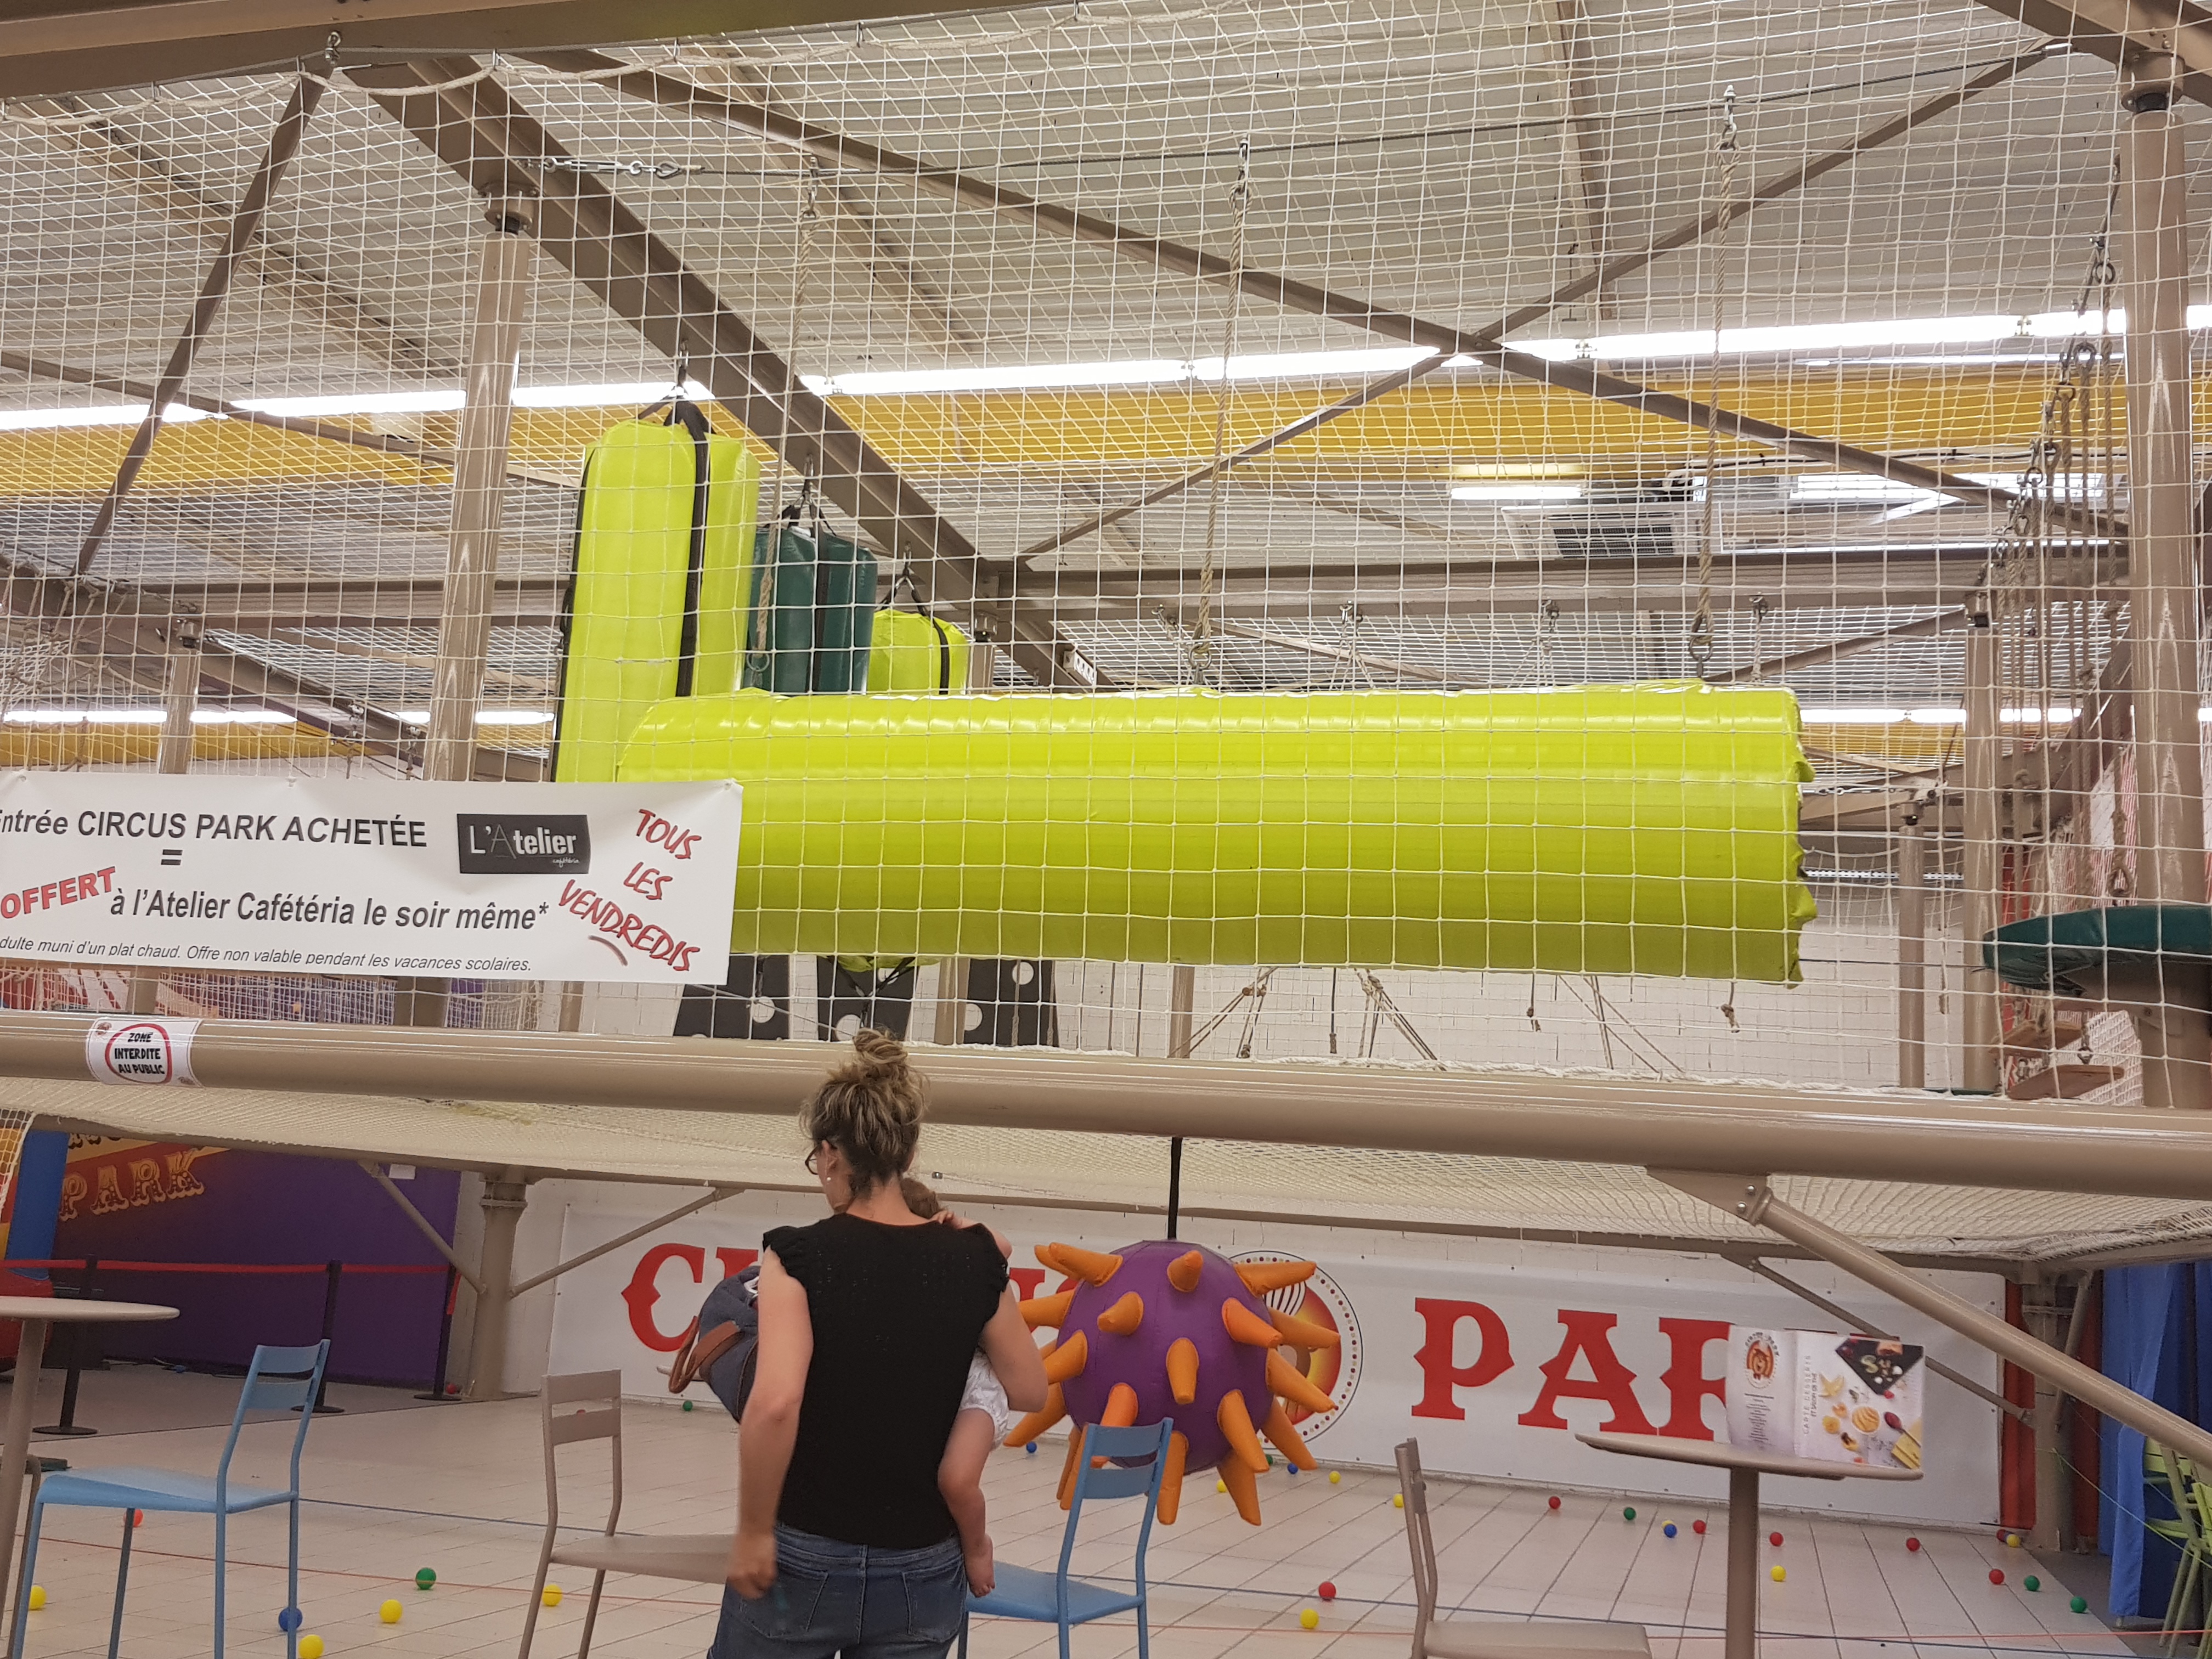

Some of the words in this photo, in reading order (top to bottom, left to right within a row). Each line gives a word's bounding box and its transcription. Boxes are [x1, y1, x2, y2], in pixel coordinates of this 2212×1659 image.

[0, 810, 68, 835] ntrée
[78, 810, 187, 839] CIRCUS
[195, 814, 277, 840] PARK
[281, 814, 427, 848] ACHETÉE
[470, 824, 577, 860] L'Atelier
[636, 809, 702, 859] TOUS
[1, 866, 116, 918] OFFERT
[623, 862, 673, 900] LES
[110, 888, 125, 915] à
[133, 889, 231, 919] l'Atelier
[238, 892, 354, 924] Cafétéria
[363, 898, 387, 926] le
[395, 901, 450, 928] soir
[558, 879, 701, 972] VENDREDIS
[37, 940, 75, 953] muni
[76, 940, 106, 955] d'un
[109, 943, 134, 957] plat
[137, 944, 180, 958] chaud.
[187, 945, 220, 960] Offre
[223, 950, 250, 962] non
[254, 949, 302, 963] valable
[306, 952, 366, 967] pendant
[368, 953, 390, 967] les
[394, 956, 462, 969] vacances
[465, 957, 532, 971] scolaires.
[114, 1048, 161, 1059] INTERDITE
[128, 1032, 153, 1042] ZONE
[118, 1064, 132, 1074] AU
[134, 1064, 165, 1075] PUBLIC
[59, 1149, 205, 1222] PARK
[1412, 1297, 1734, 1442] PAR
